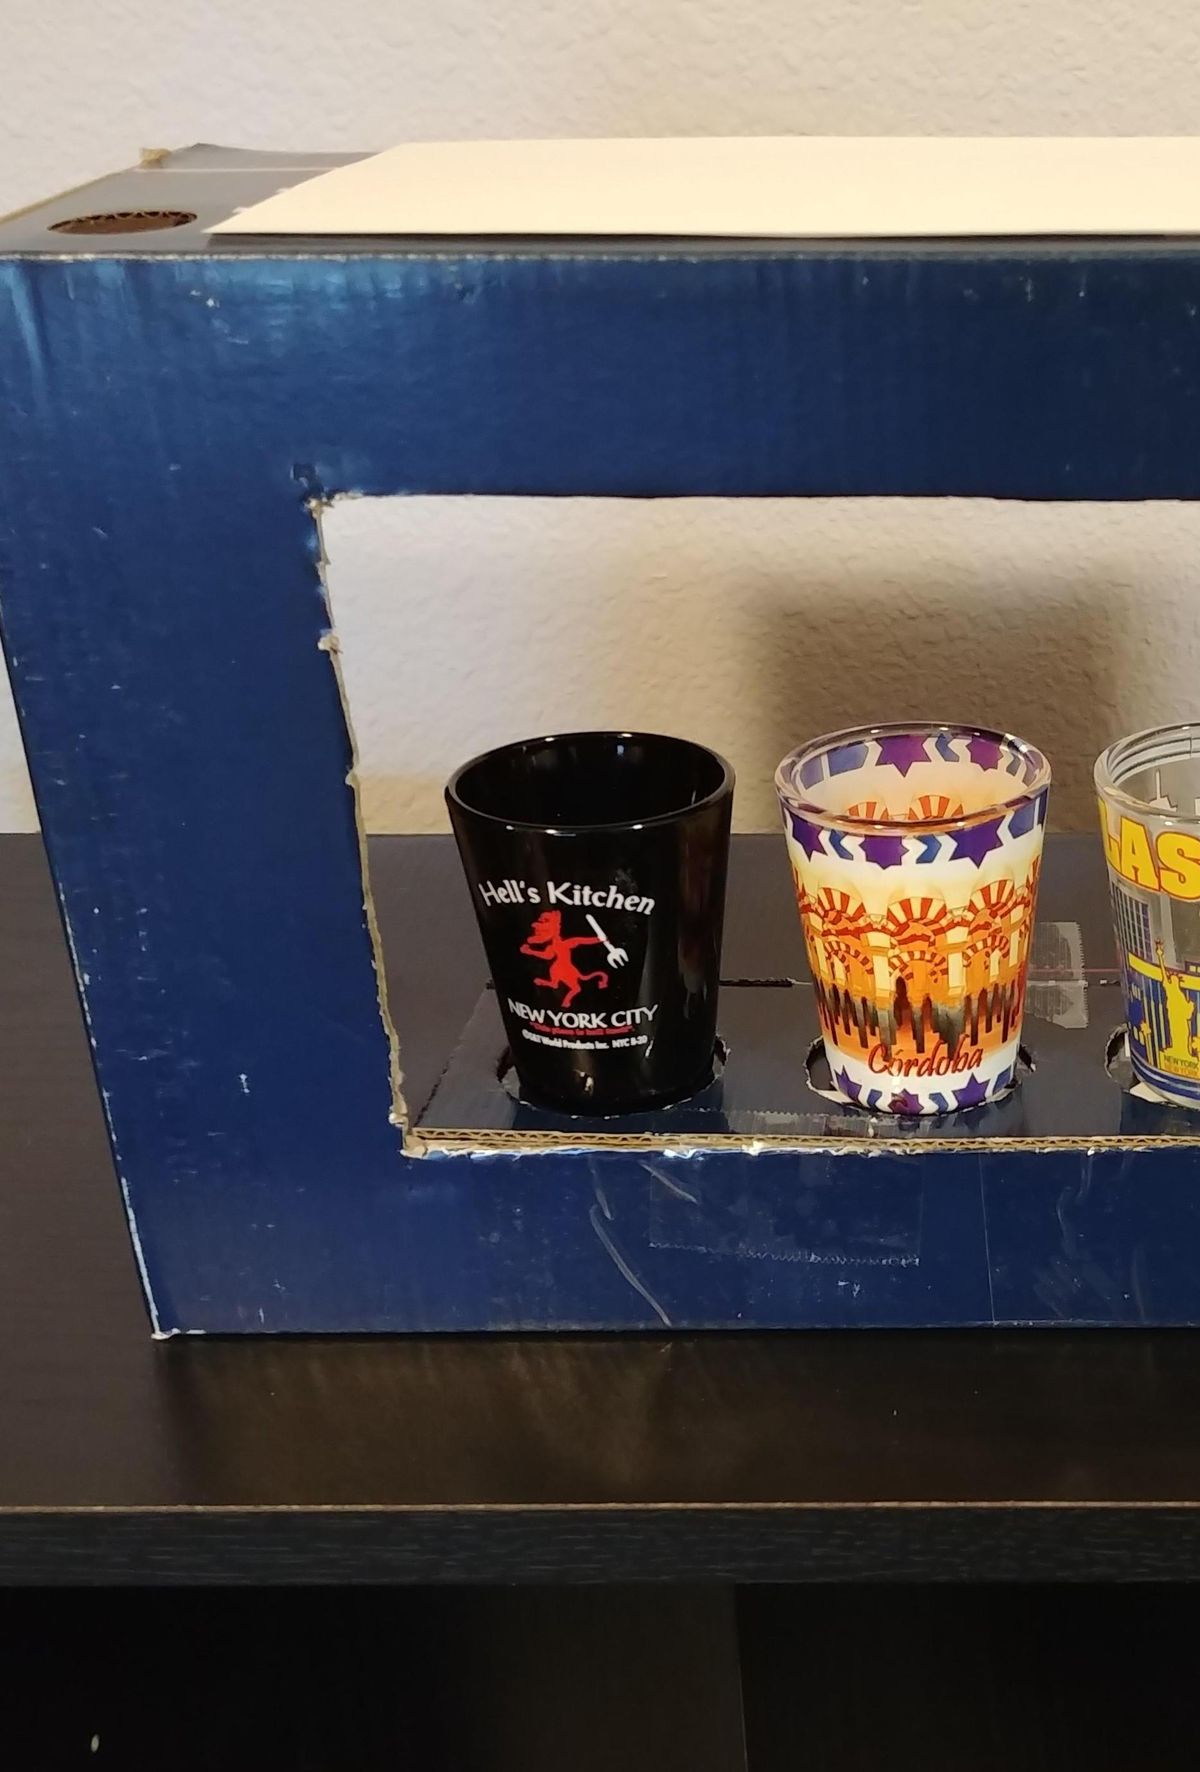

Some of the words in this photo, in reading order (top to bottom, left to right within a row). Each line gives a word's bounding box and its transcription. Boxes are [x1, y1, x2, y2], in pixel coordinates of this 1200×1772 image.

[478, 879, 541, 907] Hell's
[546, 881, 655, 916] Kitchen
[507, 998, 545, 1024] NEW
[547, 1011, 608, 1029] YORK
[611, 1004, 658, 1027] CITY
